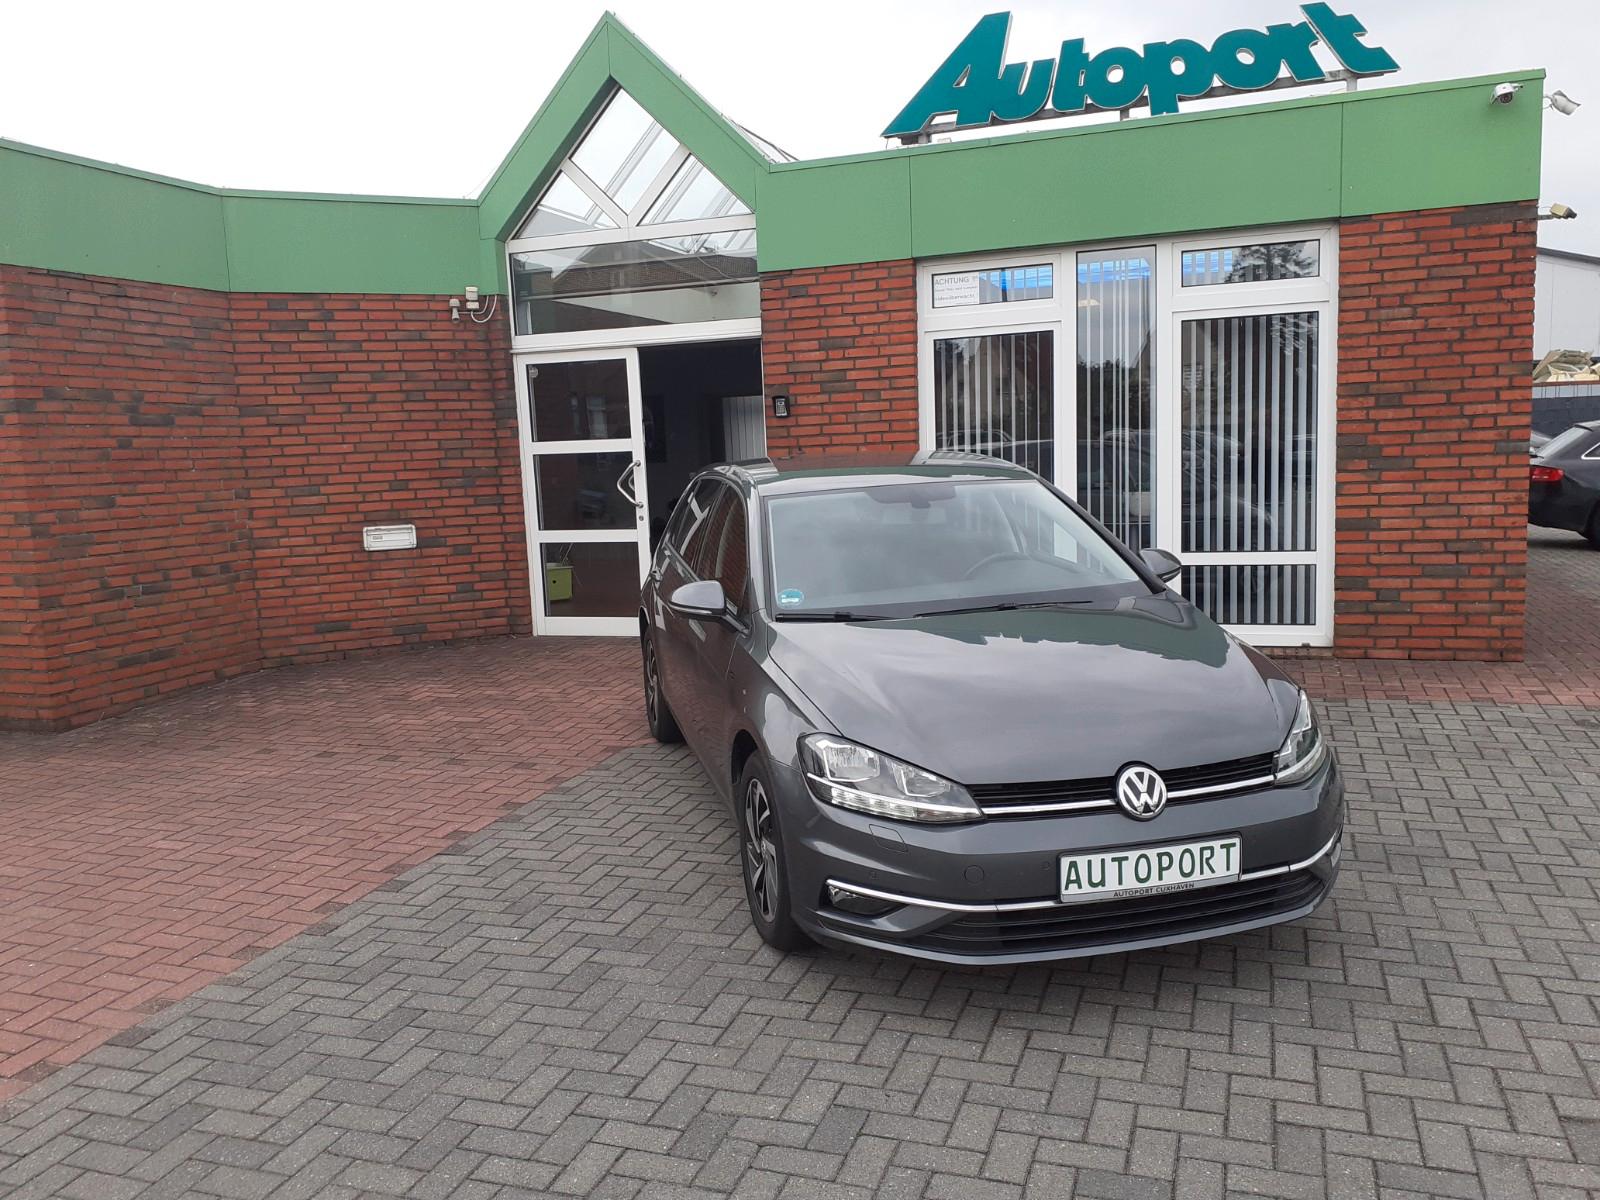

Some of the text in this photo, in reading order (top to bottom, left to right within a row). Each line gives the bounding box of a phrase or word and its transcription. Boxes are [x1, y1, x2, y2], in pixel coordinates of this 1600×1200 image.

[882, 2, 1399, 136] Autoport
[935, 276, 970, 286] ACHTUNG
[1119, 766, 1167, 815] VW
[1064, 843, 1237, 891] AUTOPORT
[1113, 882, 1195, 898] AUTOPORT CUXHAVEN
